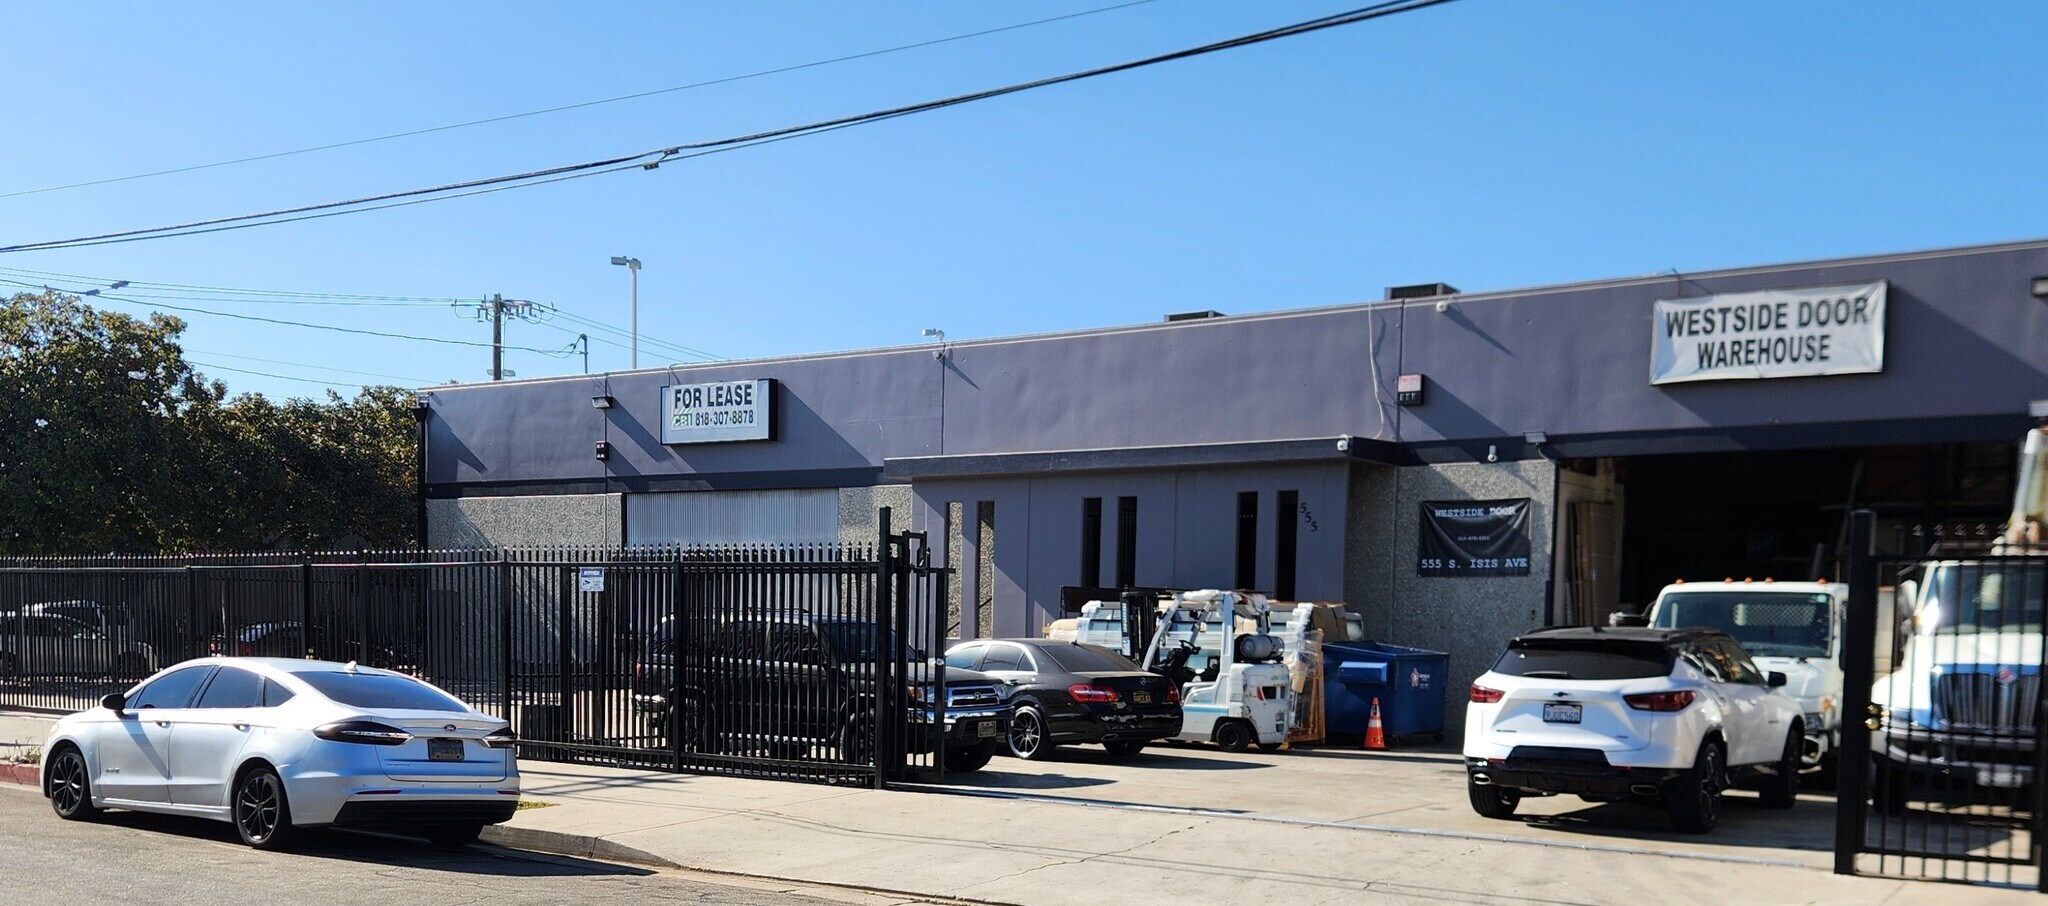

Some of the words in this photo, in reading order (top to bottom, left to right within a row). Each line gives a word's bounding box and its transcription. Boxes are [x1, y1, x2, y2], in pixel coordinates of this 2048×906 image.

[1666, 303, 1788, 338] WESTSIDE
[1797, 298, 1868, 327] DOOR
[1698, 335, 1831, 369] WAREHOUSE
[674, 388, 702, 409] FOR
[707, 384, 752, 407] LEASE
[1435, 508, 1484, 517] WESTSIDE
[1489, 507, 1516, 516] DOOR
[1421, 559, 1442, 569] 555
[1448, 559, 1461, 569] S.
[1469, 559, 1498, 569] ISIS
[1504, 558, 1528, 568] AVE
